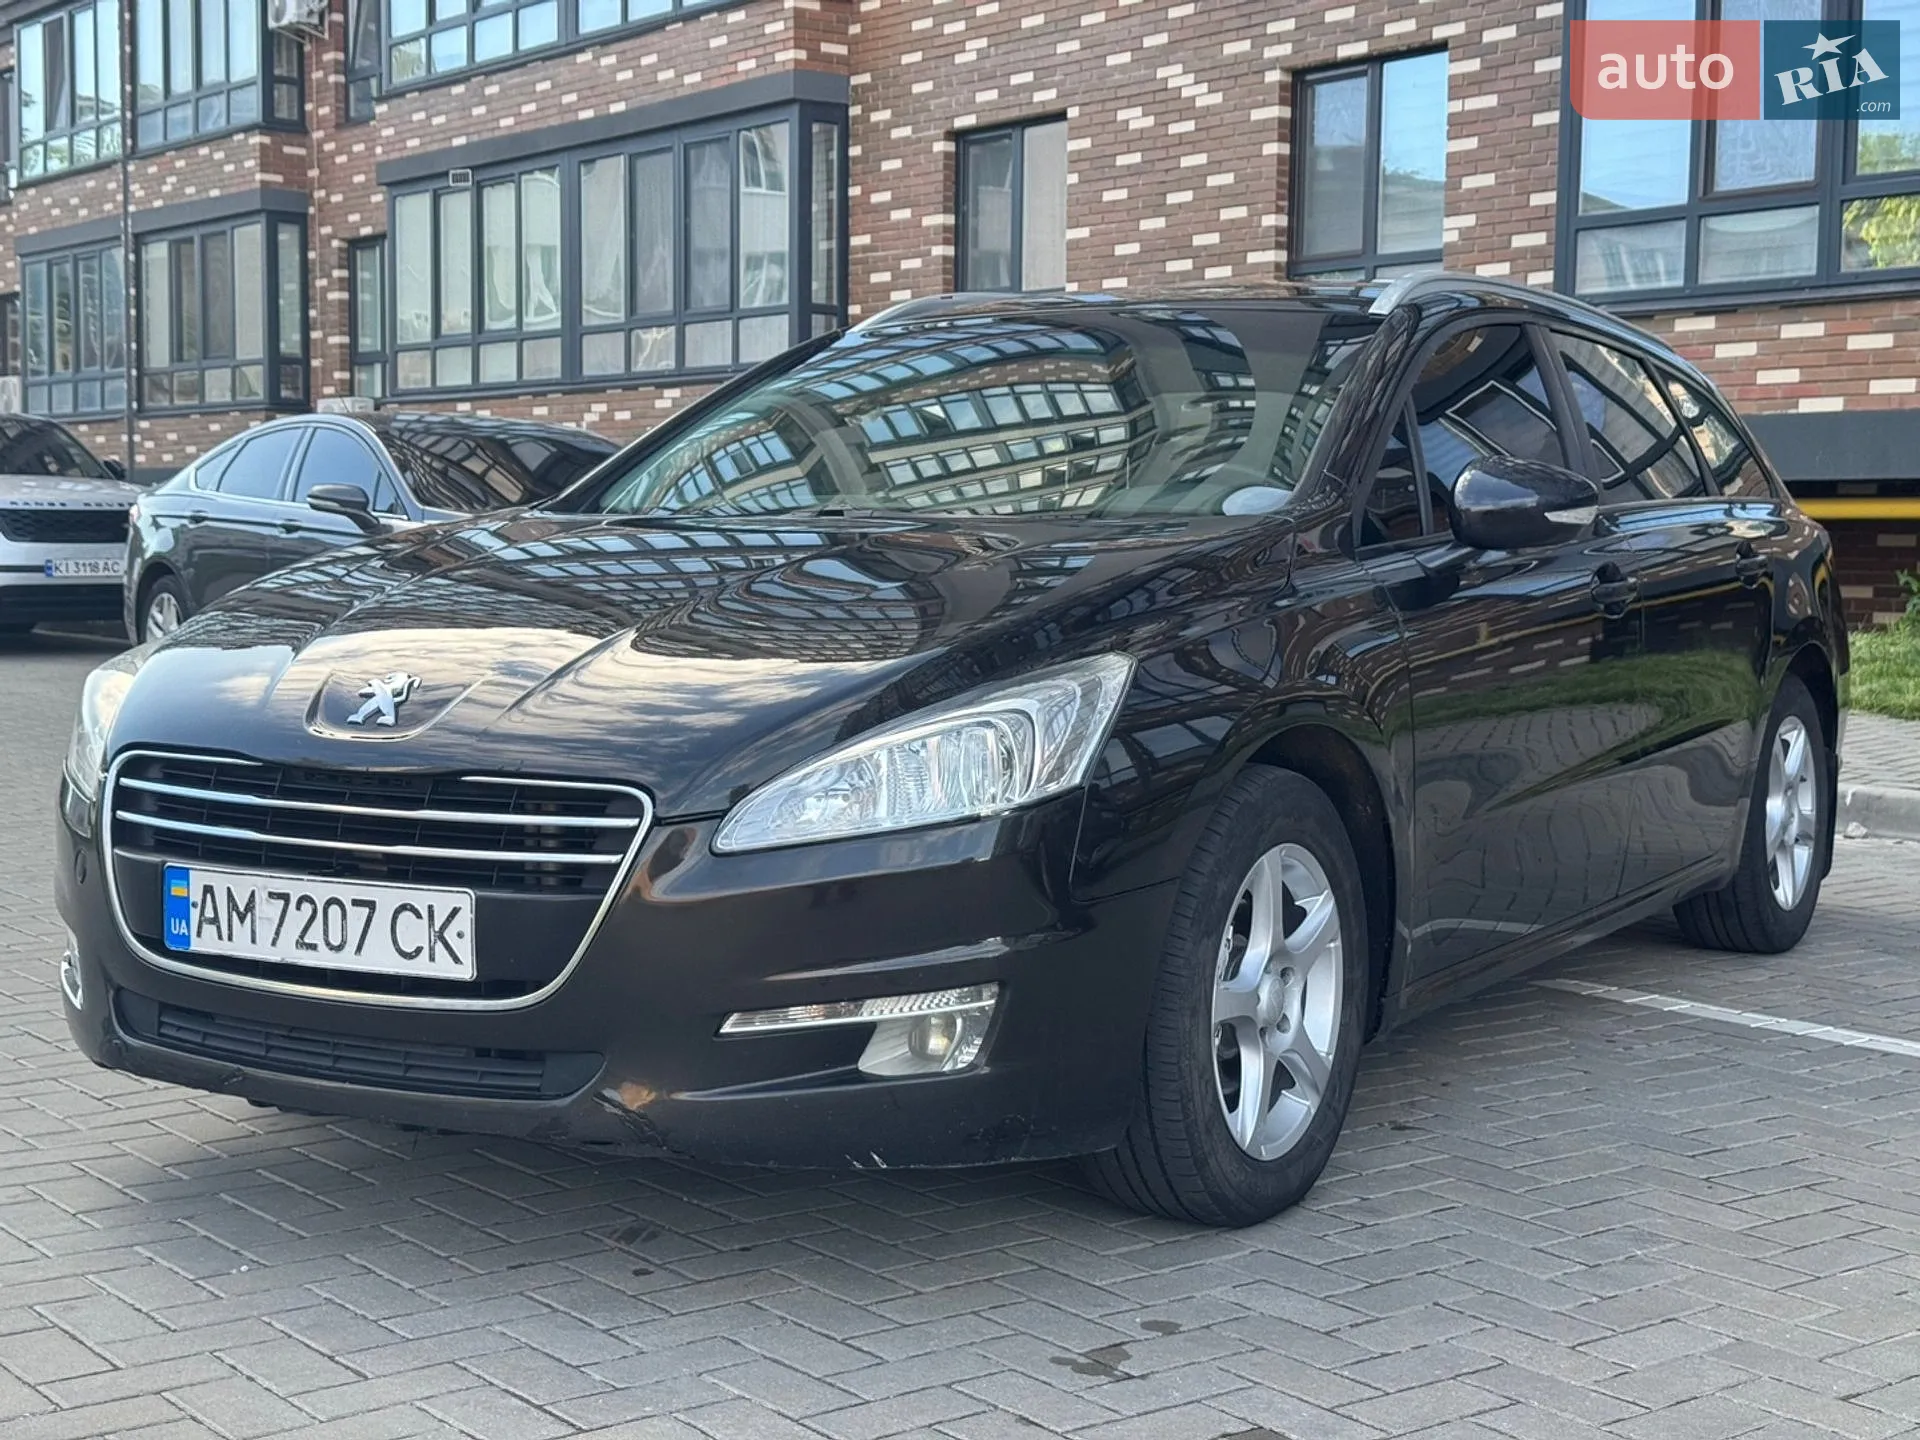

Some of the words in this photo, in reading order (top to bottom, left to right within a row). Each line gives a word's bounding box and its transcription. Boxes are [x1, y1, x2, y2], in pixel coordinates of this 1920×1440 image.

[102, 561, 121, 574] AC
[170, 918, 189, 936] UA
[196, 883, 258, 945] AM
[267, 890, 377, 956] 7207
[390, 902, 464, 966] CK
